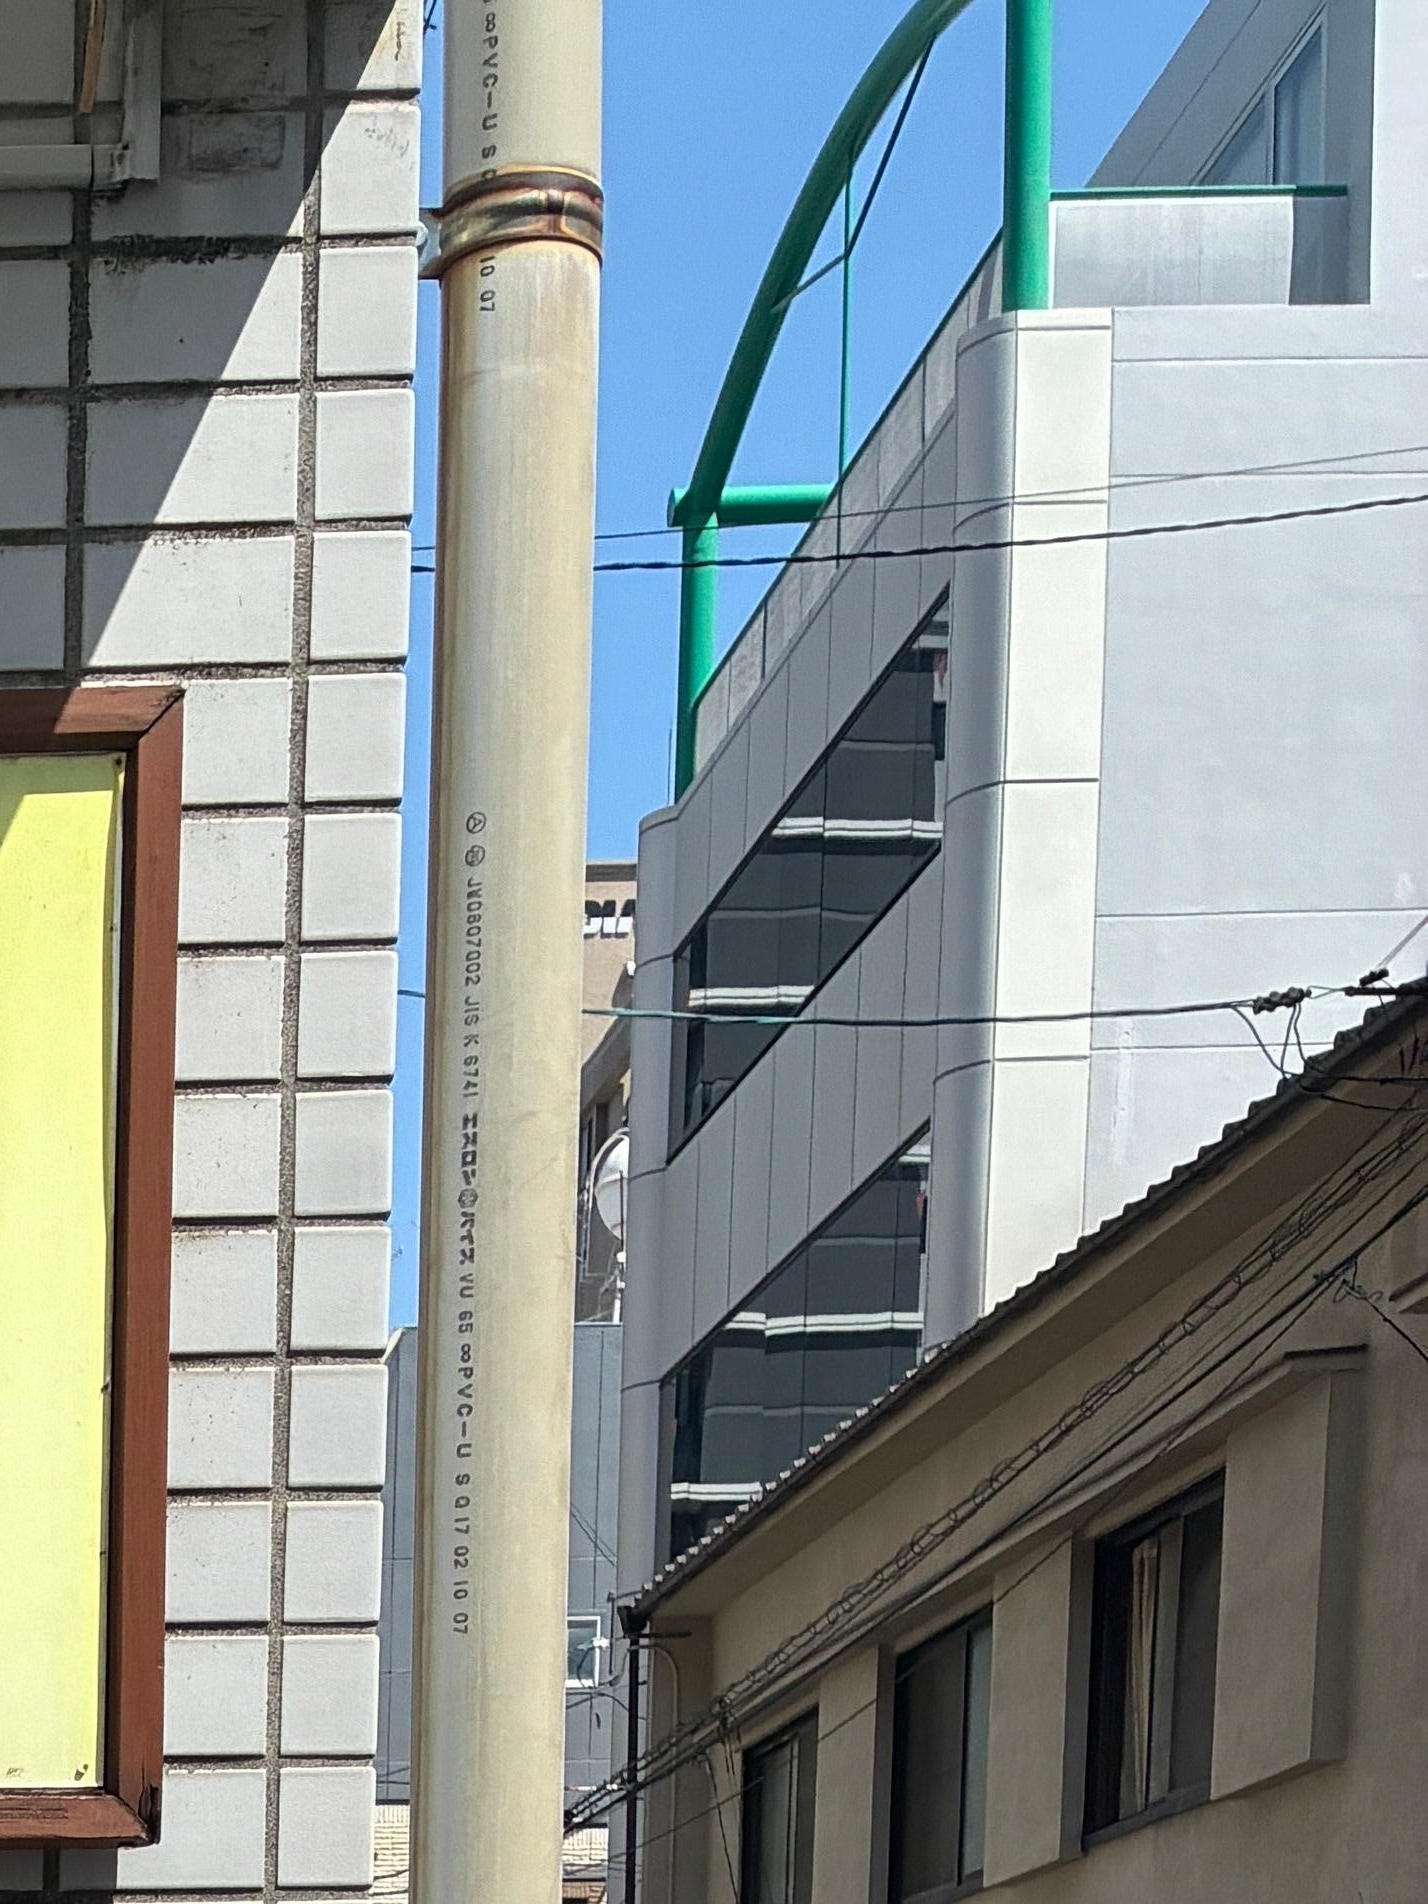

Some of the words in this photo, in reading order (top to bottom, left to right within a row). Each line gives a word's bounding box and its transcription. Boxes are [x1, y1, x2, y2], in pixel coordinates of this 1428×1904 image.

[464, 996, 480, 1026] JIS
[459, 1273, 474, 1298] VU
[458, 1311, 473, 1333] 65
[454, 1546, 469, 1569] 02
[453, 1613, 468, 1634] 07
